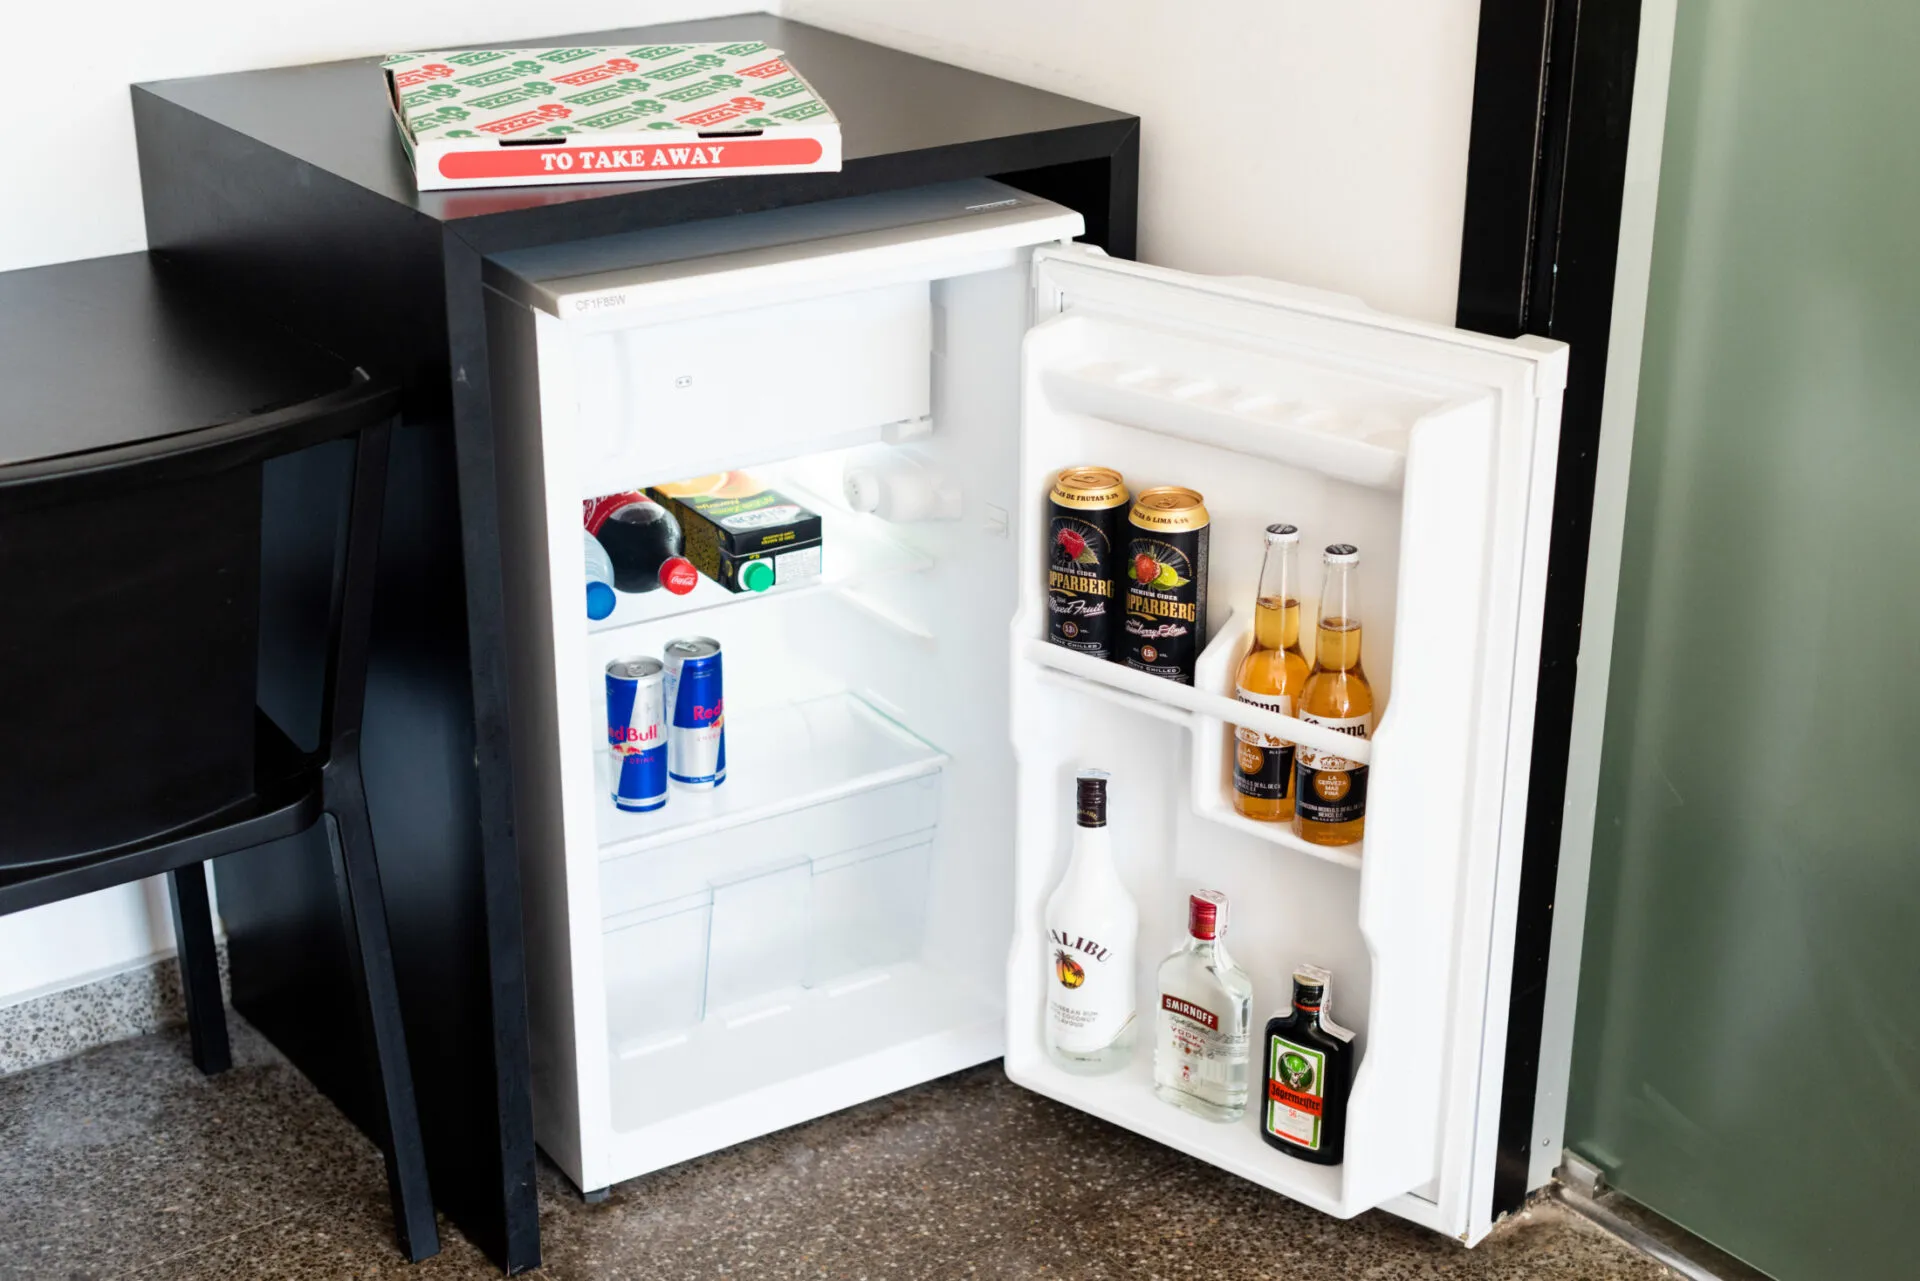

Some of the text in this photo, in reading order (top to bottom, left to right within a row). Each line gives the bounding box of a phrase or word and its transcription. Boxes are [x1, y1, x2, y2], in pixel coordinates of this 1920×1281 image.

[541, 146, 725, 171] TO TAKE AWAY
[1066, 493, 1075, 501] DE
[1157, 593, 1178, 601] CIDER
[693, 700, 721, 720] Red
[626, 723, 657, 742] Bull
[1046, 929, 1112, 963] ALIBU
[1166, 998, 1213, 1025] SMIRNOFF
[1171, 1026, 1205, 1044] VODKA
